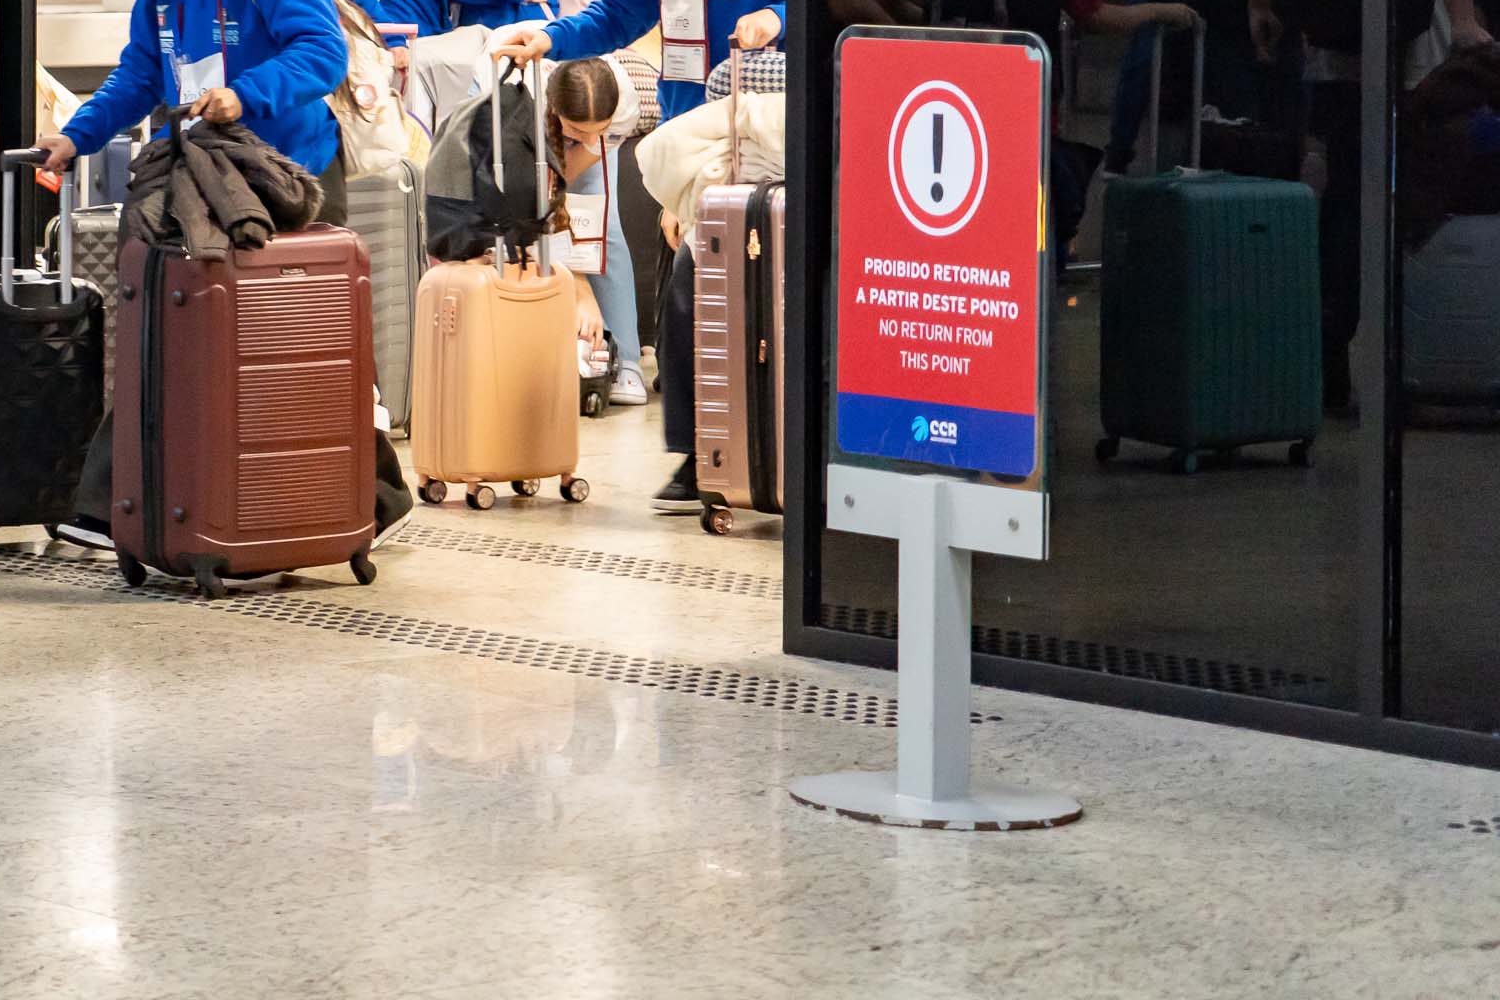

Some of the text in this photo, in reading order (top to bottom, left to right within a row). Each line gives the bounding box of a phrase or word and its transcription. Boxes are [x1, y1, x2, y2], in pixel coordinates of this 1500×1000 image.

[864, 258, 1010, 287] PROIBIDO RETORNAR
[856, 287, 1018, 319] A PARTIR DESTE PONTO
[879, 320, 993, 347] NO RETURN FROM
[900, 351, 971, 375] THIS POINT
[930, 420, 957, 437] CCR
